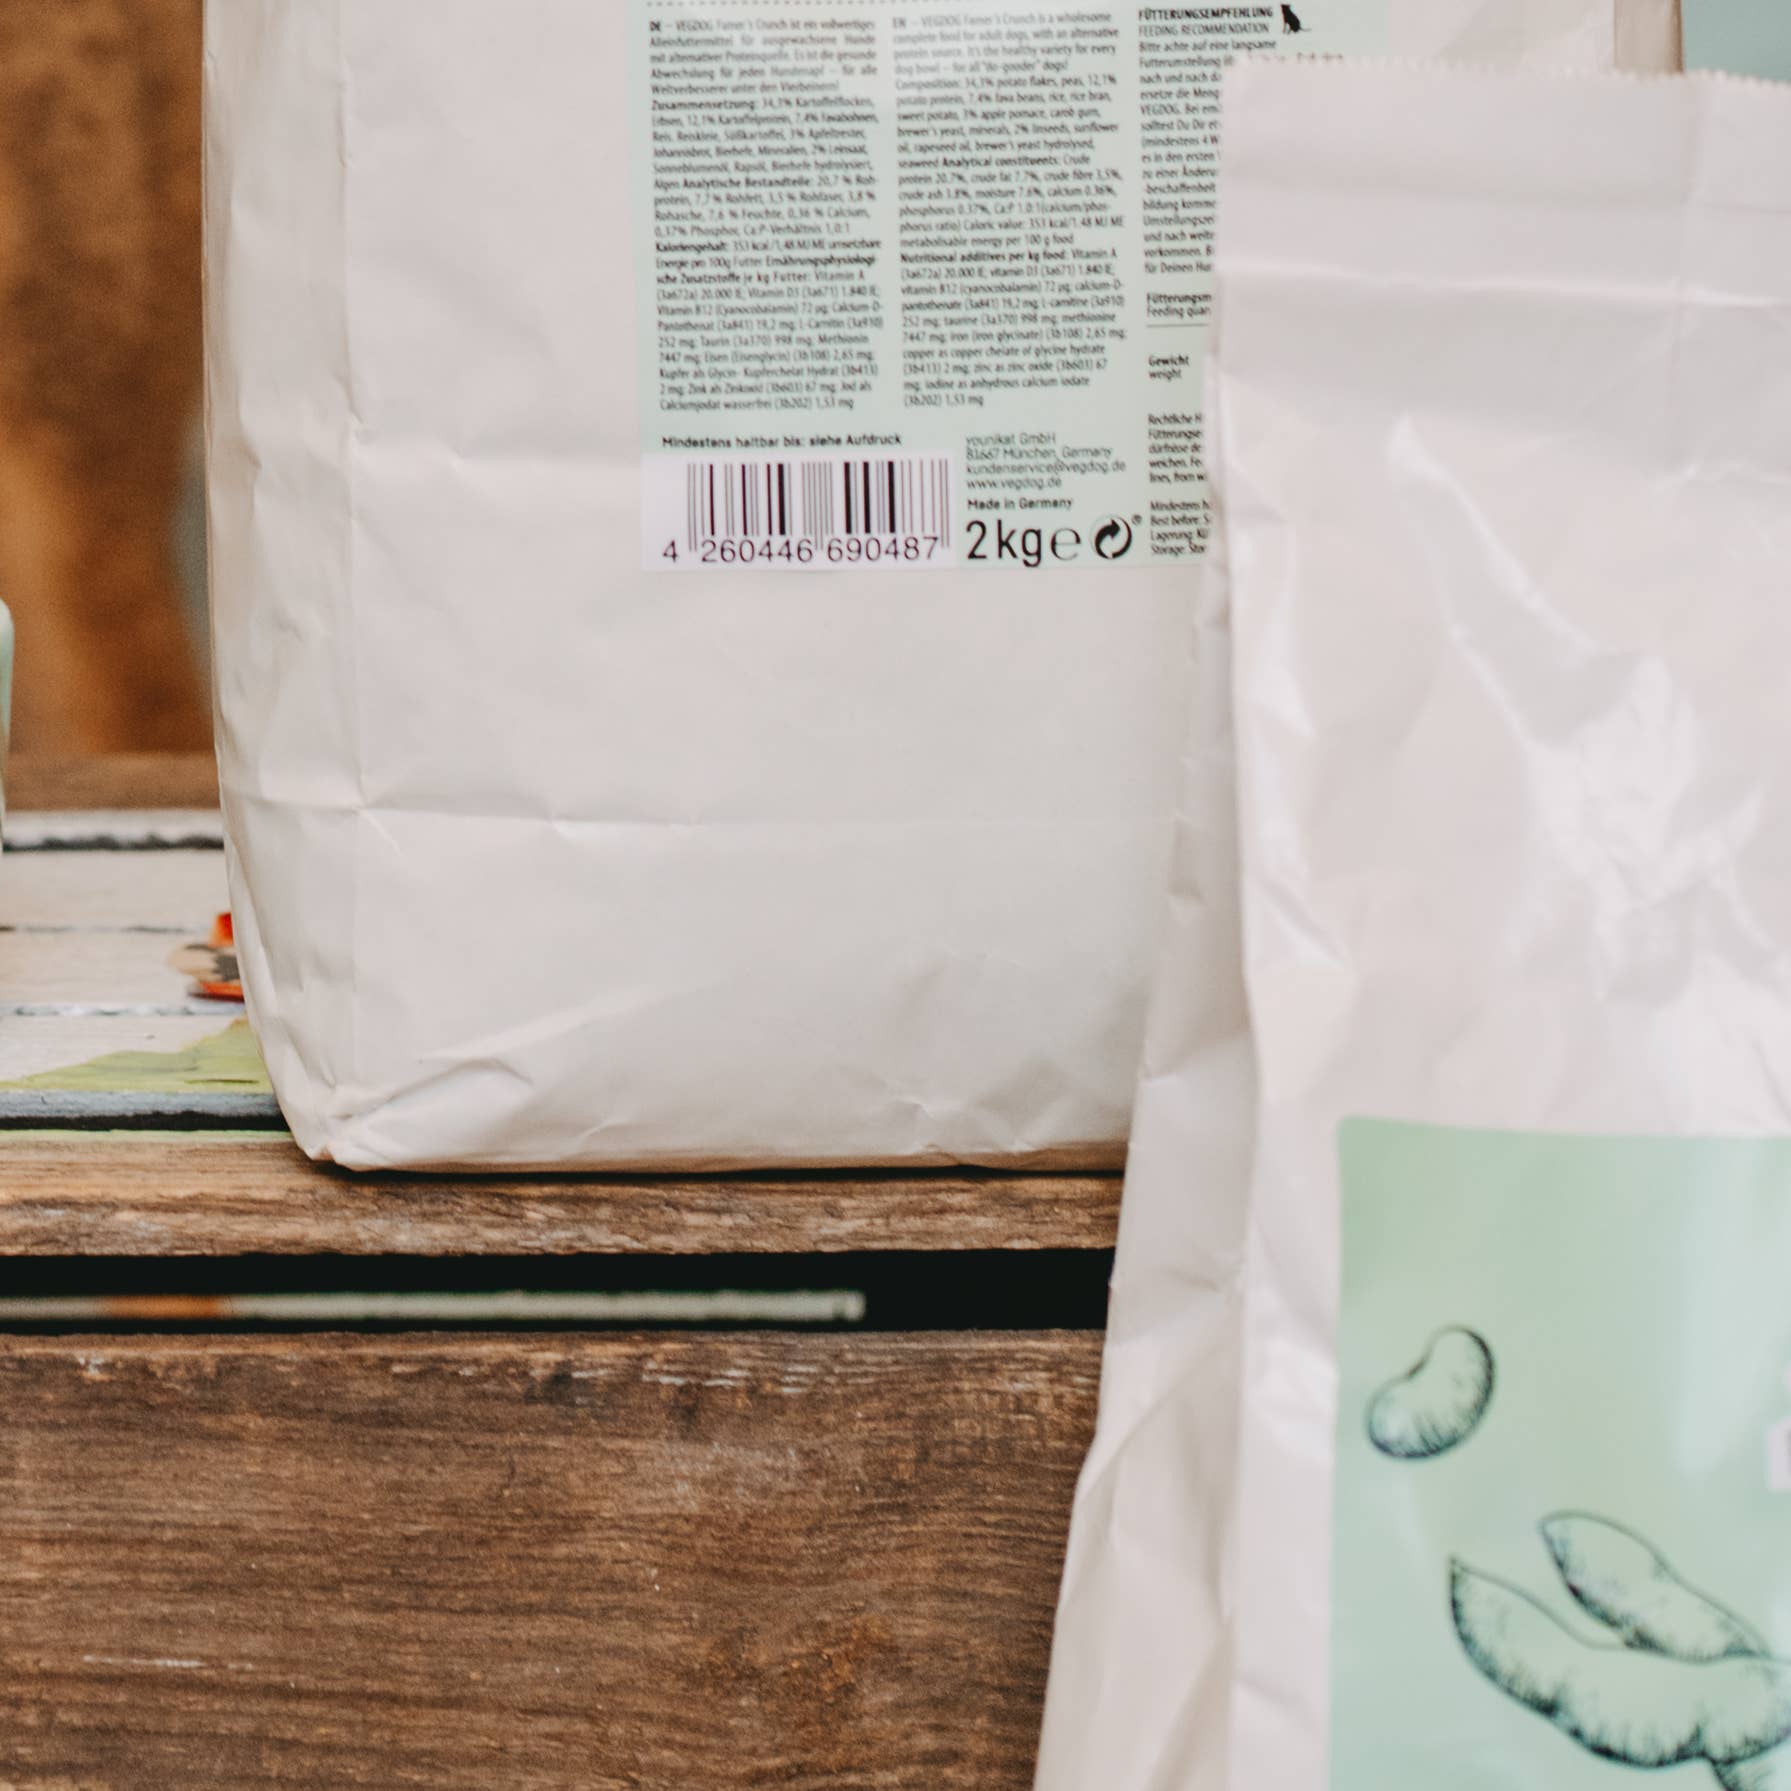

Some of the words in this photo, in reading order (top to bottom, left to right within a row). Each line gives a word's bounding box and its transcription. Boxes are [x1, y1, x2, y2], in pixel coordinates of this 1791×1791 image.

[1139, 24, 1178, 37] FEEDING
[1181, 22, 1269, 36] RECOMMENDATION
[1148, 355, 1189, 367] Gewicht
[1148, 368, 1182, 382] weight
[661, 435, 732, 449] Mindestens
[735, 435, 780, 448] haltbar
[808, 434, 842, 447] siehe
[846, 433, 903, 447] Aufdruck
[1019, 432, 1056, 445] GmbH
[966, 448, 999, 460] 81667
[1061, 446, 1113, 461] Germany
[967, 498, 1000, 509] Made
[1004, 497, 1015, 509] in
[1019, 496, 1073, 513] Germany
[662, 539, 679, 563] 4
[701, 538, 813, 563] 260446
[826, 535, 941, 563] 690487
